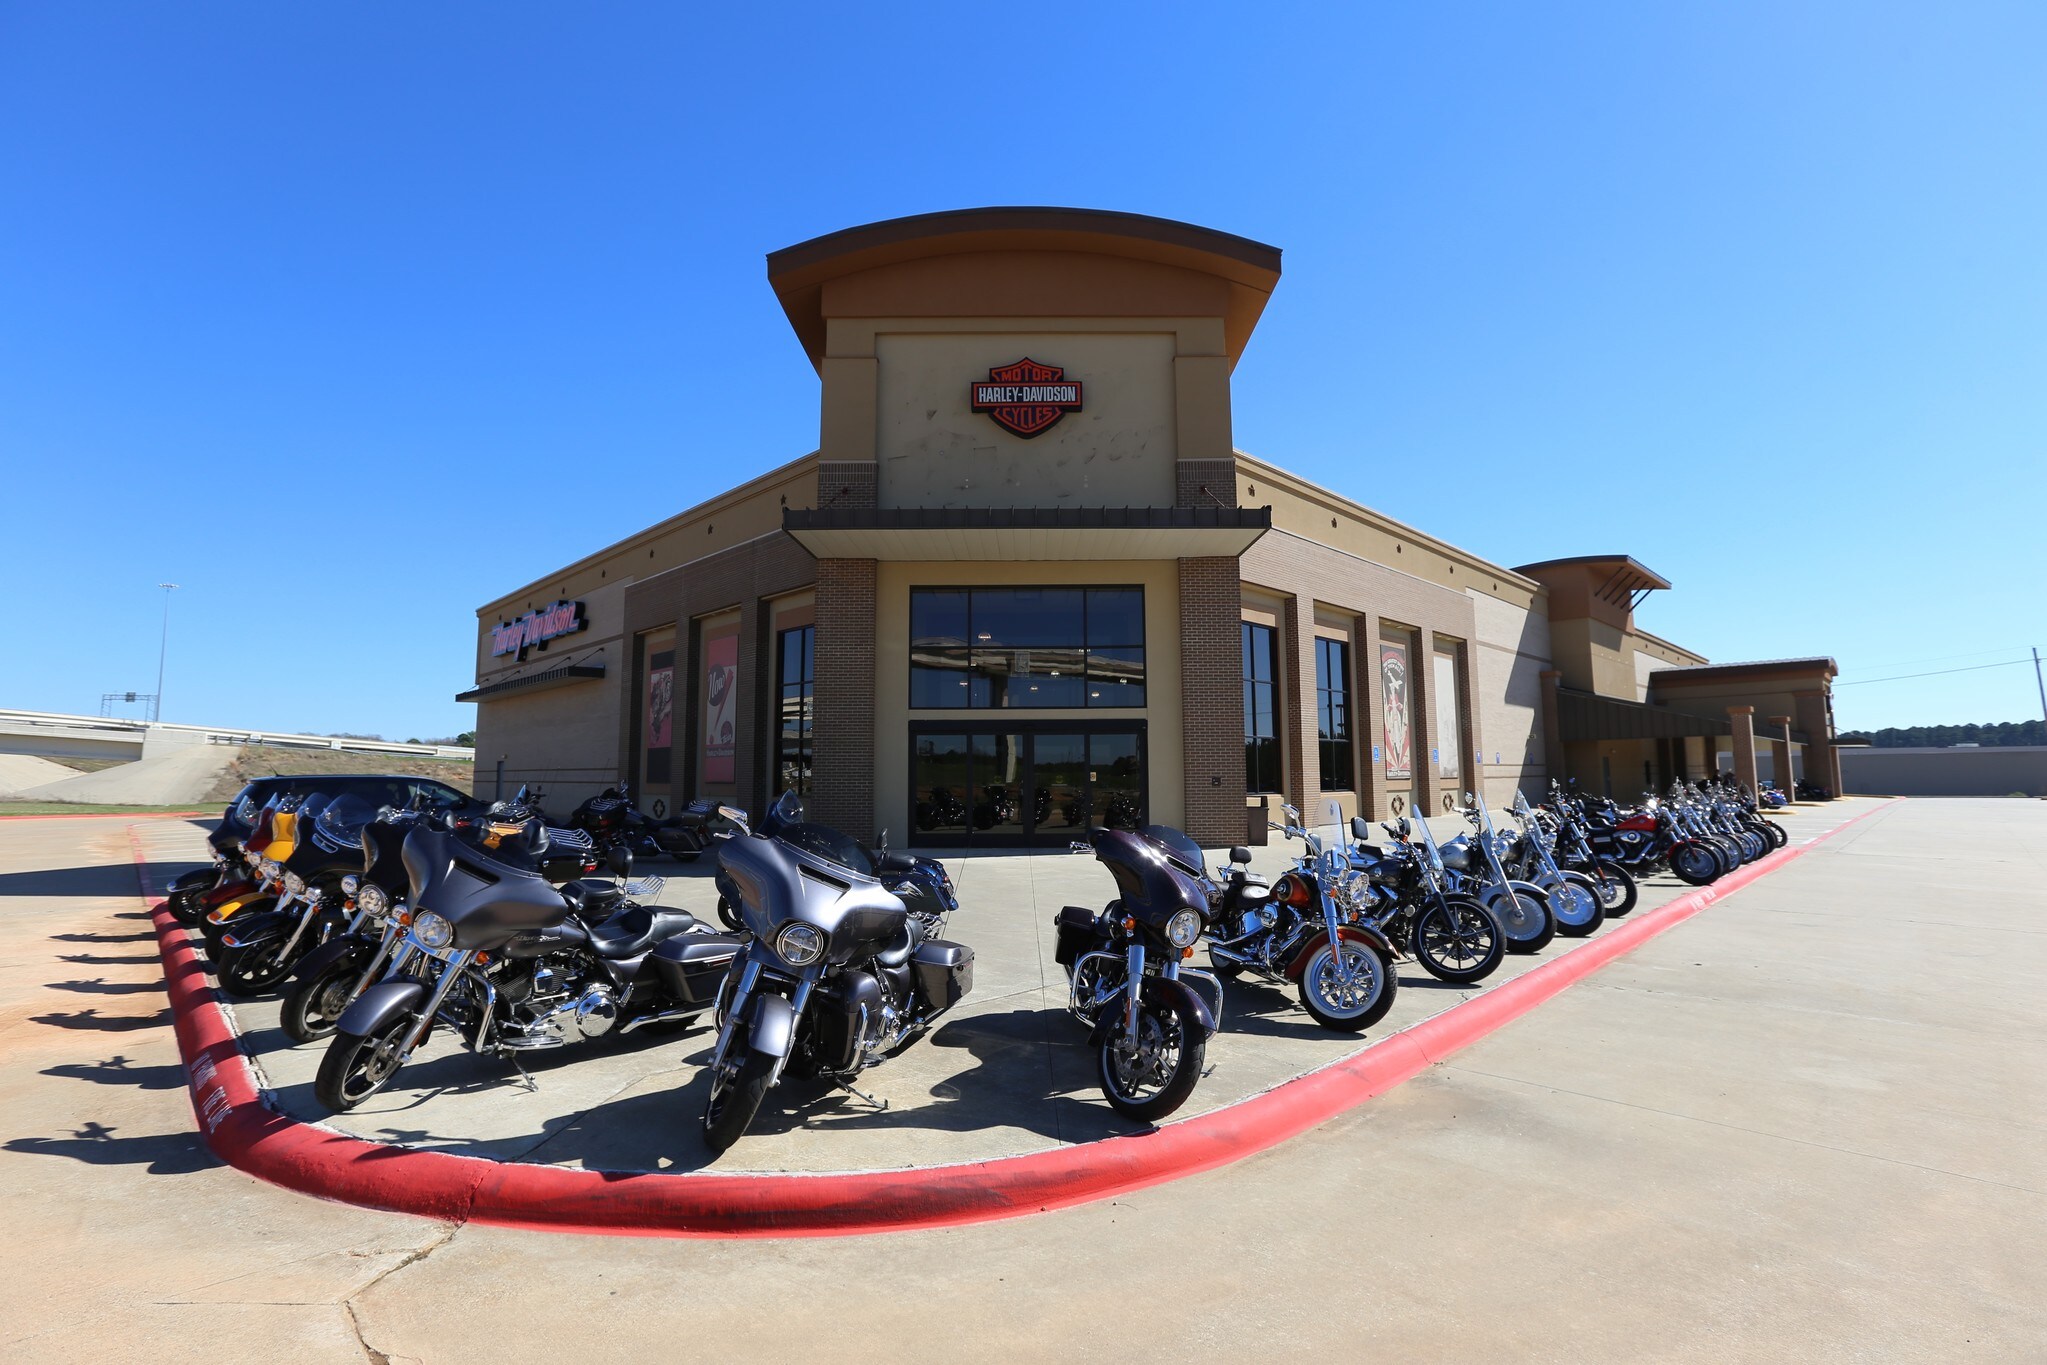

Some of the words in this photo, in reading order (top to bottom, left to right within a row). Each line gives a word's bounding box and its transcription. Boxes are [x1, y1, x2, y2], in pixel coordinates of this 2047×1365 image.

[1001, 365, 1052, 381] MOTOR
[978, 386, 1076, 403] HARLEY-DAVIDSON
[1002, 407, 1052, 428] CYCLES
